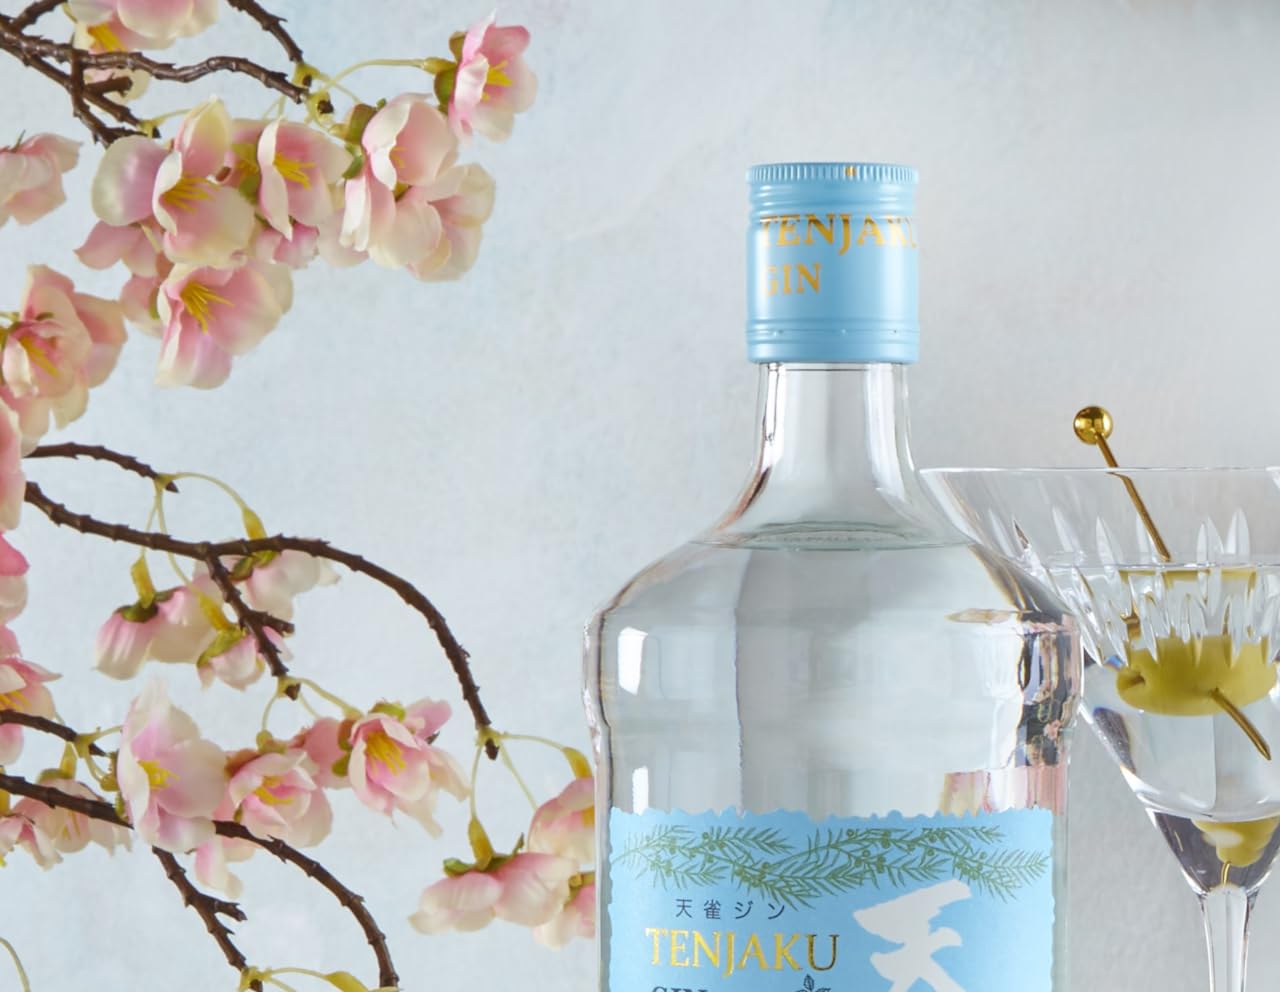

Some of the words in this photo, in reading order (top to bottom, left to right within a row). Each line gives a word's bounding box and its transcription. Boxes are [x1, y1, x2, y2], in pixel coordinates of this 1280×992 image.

[675, 898, 785, 920] 天雀ジン
[645, 927, 840, 980] TENJAKU
